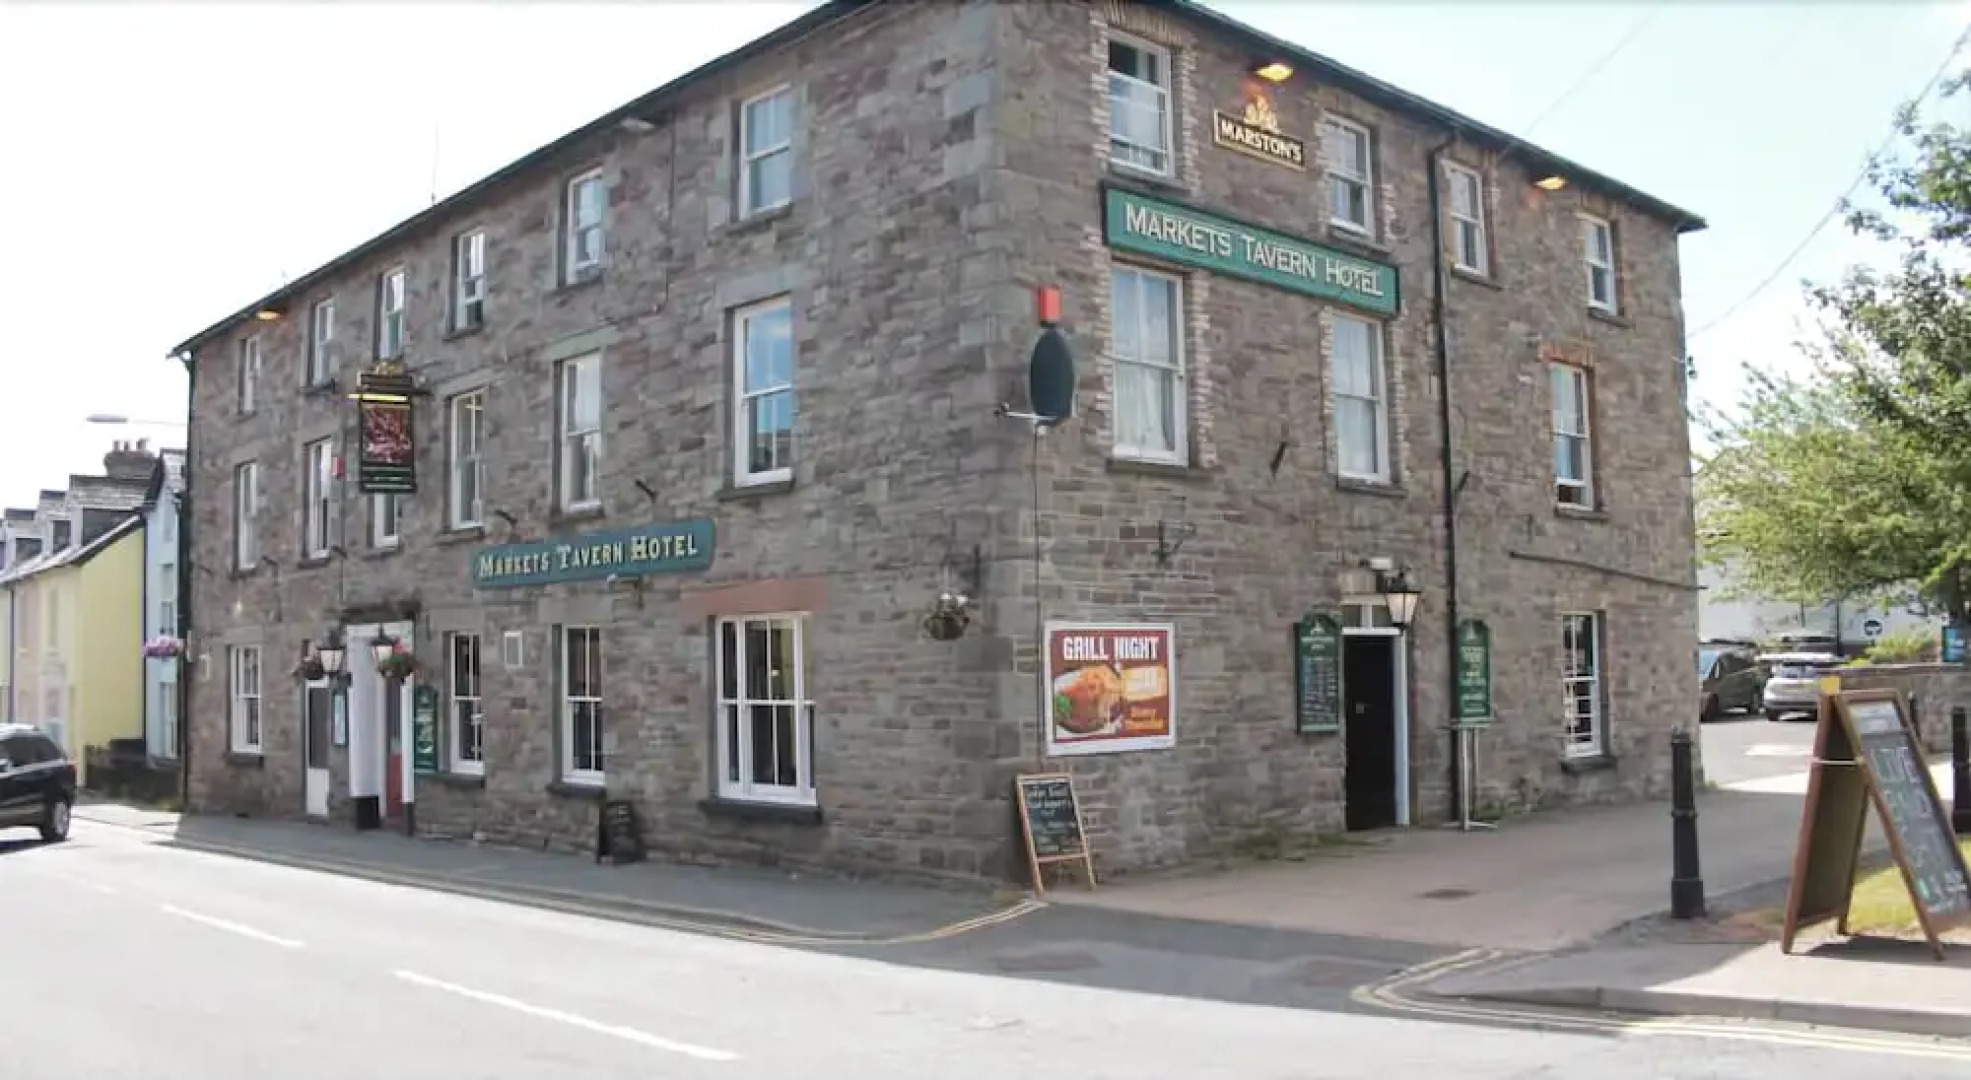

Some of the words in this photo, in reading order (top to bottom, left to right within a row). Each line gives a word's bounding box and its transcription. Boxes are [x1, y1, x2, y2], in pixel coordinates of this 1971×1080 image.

[1221, 118, 1302, 161] MARSTON'S
[1125, 203, 1231, 256] MARKETS
[1241, 237, 1316, 278] TAVERN
[1326, 258, 1383, 296] HOTEL
[479, 552, 548, 578] MARKETS
[557, 542, 622, 569] TAVERN
[631, 533, 698, 561] HOTEL
[1063, 636, 1109, 660] GRILL
[1114, 635, 1160, 659] NIGHT
